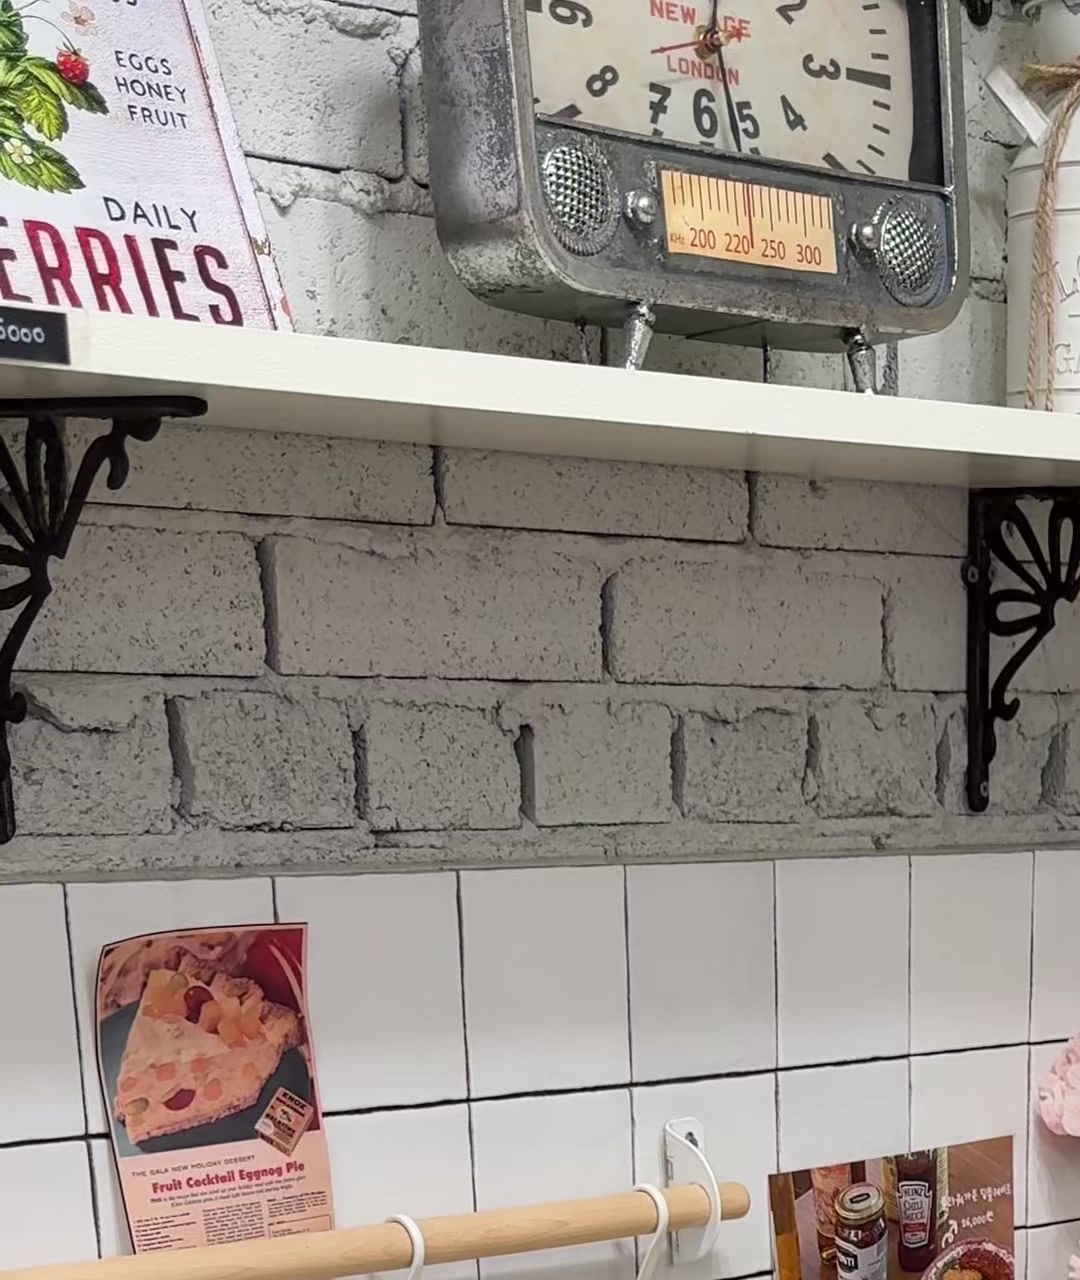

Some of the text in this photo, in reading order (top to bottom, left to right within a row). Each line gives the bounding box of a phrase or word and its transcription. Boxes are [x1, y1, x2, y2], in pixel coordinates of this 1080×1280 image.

[649, 0, 696, 24] NEW
[115, 49, 173, 76] EGGS
[666, 54, 740, 86] LONDON
[802, 53, 842, 81] 3
[115, 76, 187, 105] HONEY
[586, 65, 619, 97] 8
[127, 104, 188, 130] FRUIT
[649, 82, 672, 124] 7
[693, 88, 719, 138] 6
[779, 94, 808, 132] 4
[735, 101, 760, 139] 5
[102, 196, 198, 234] DAILY
[690, 227, 716, 250] 200
[725, 234, 750, 255] 220
[761, 238, 786, 260] 250
[797, 244, 822, 266] 300
[152, 1179, 182, 1194] Fruit
[186, 1171, 235, 1190] Cocktail
[239, 1165, 283, 1182] Eggnog
[286, 1161, 305, 1173] Pie
